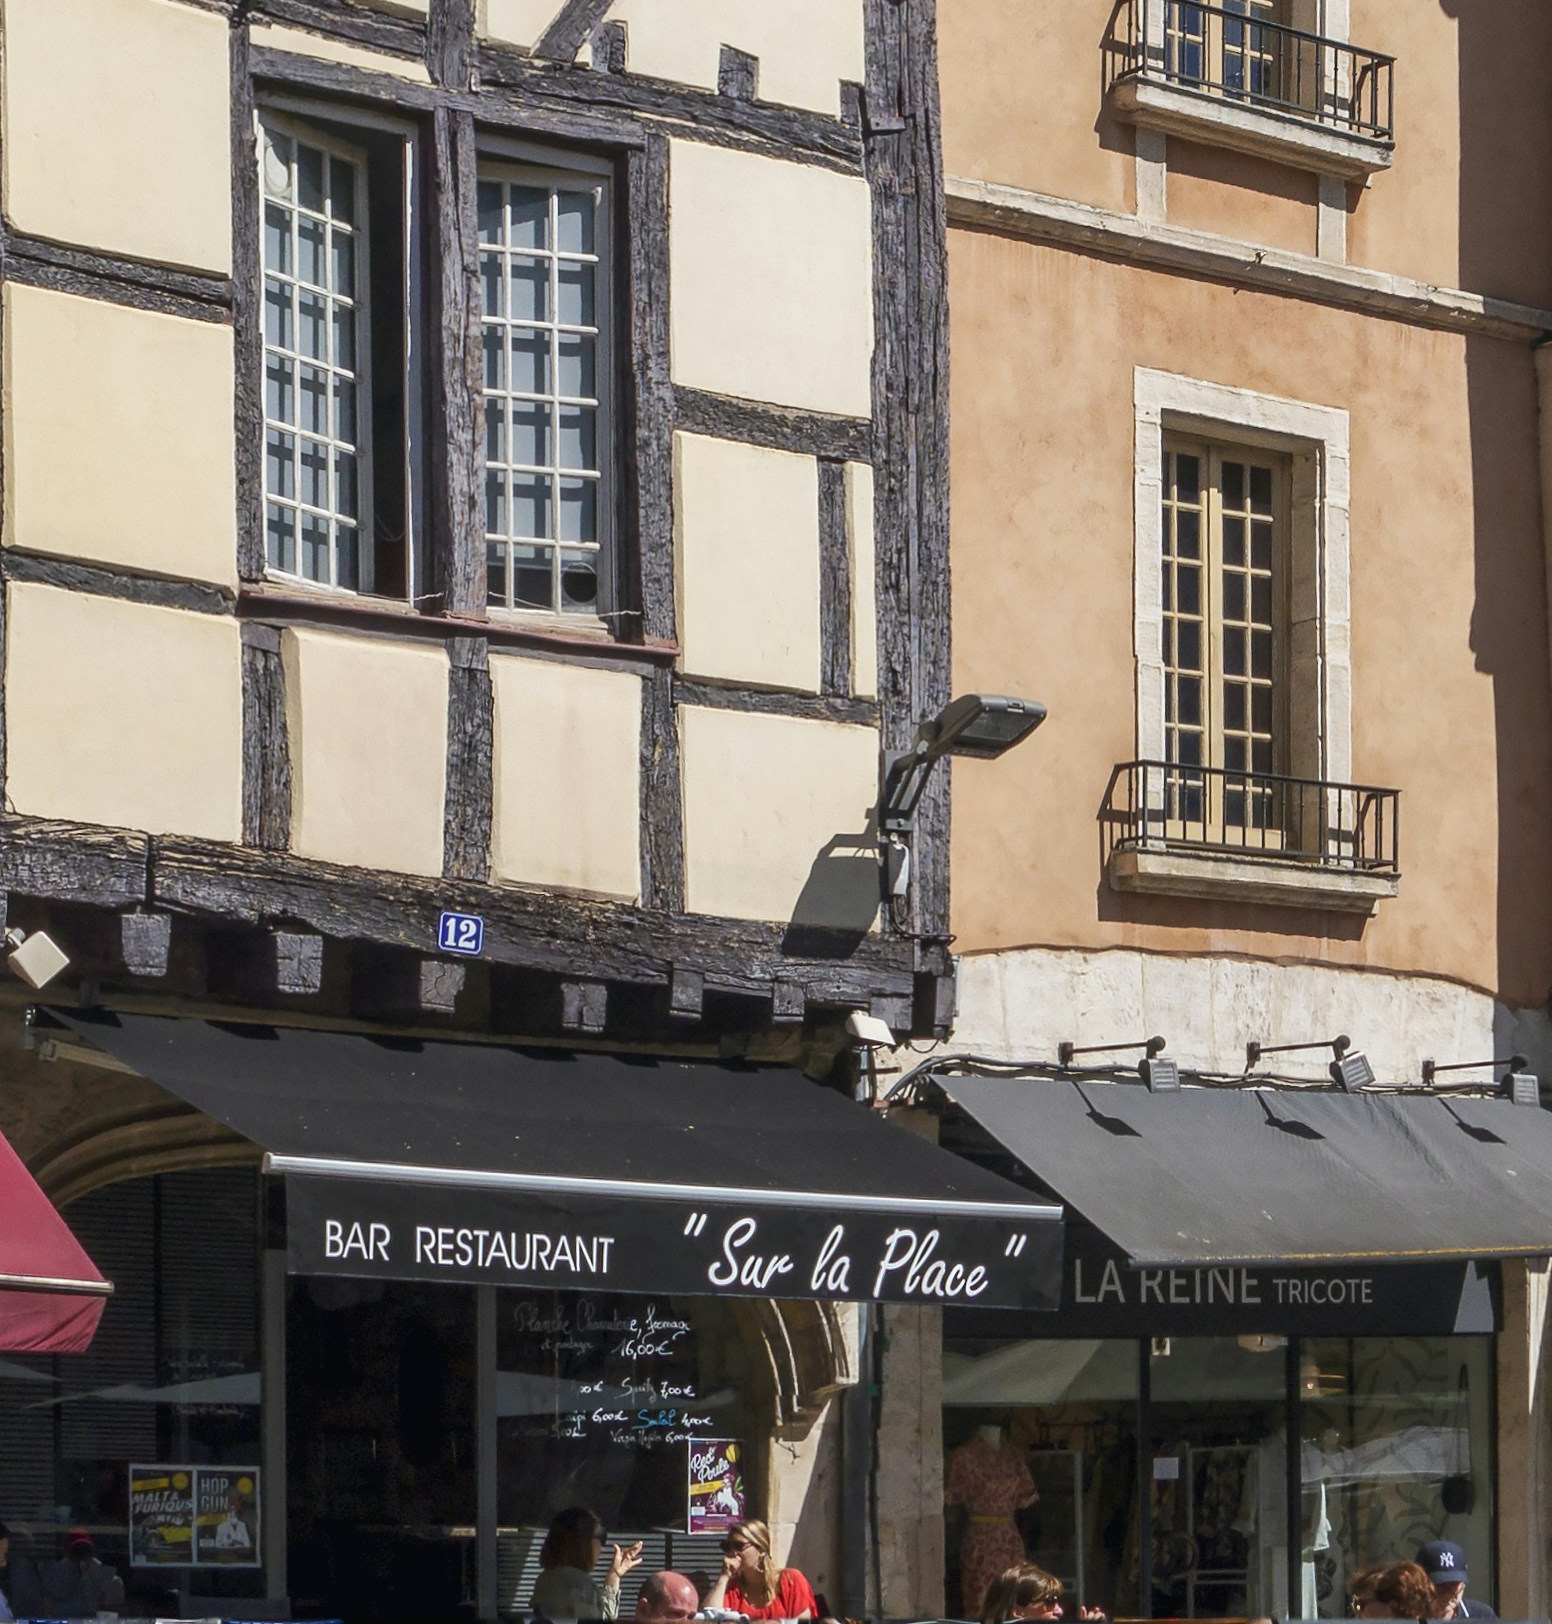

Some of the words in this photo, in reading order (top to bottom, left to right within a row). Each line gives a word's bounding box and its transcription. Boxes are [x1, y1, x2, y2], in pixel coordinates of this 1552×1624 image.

[445, 917, 476, 949] 12
[325, 1219, 391, 1262] BAR
[415, 1225, 615, 1274] RESTAURANT
[810, 1223, 850, 1293] la
[1074, 1258, 1126, 1304] LA
[1139, 1266, 1262, 1304] REINE
[1273, 1278, 1374, 1304] TRICOTE
[201, 1477, 229, 1494] HOP
[201, 1495, 229, 1512] GUN
